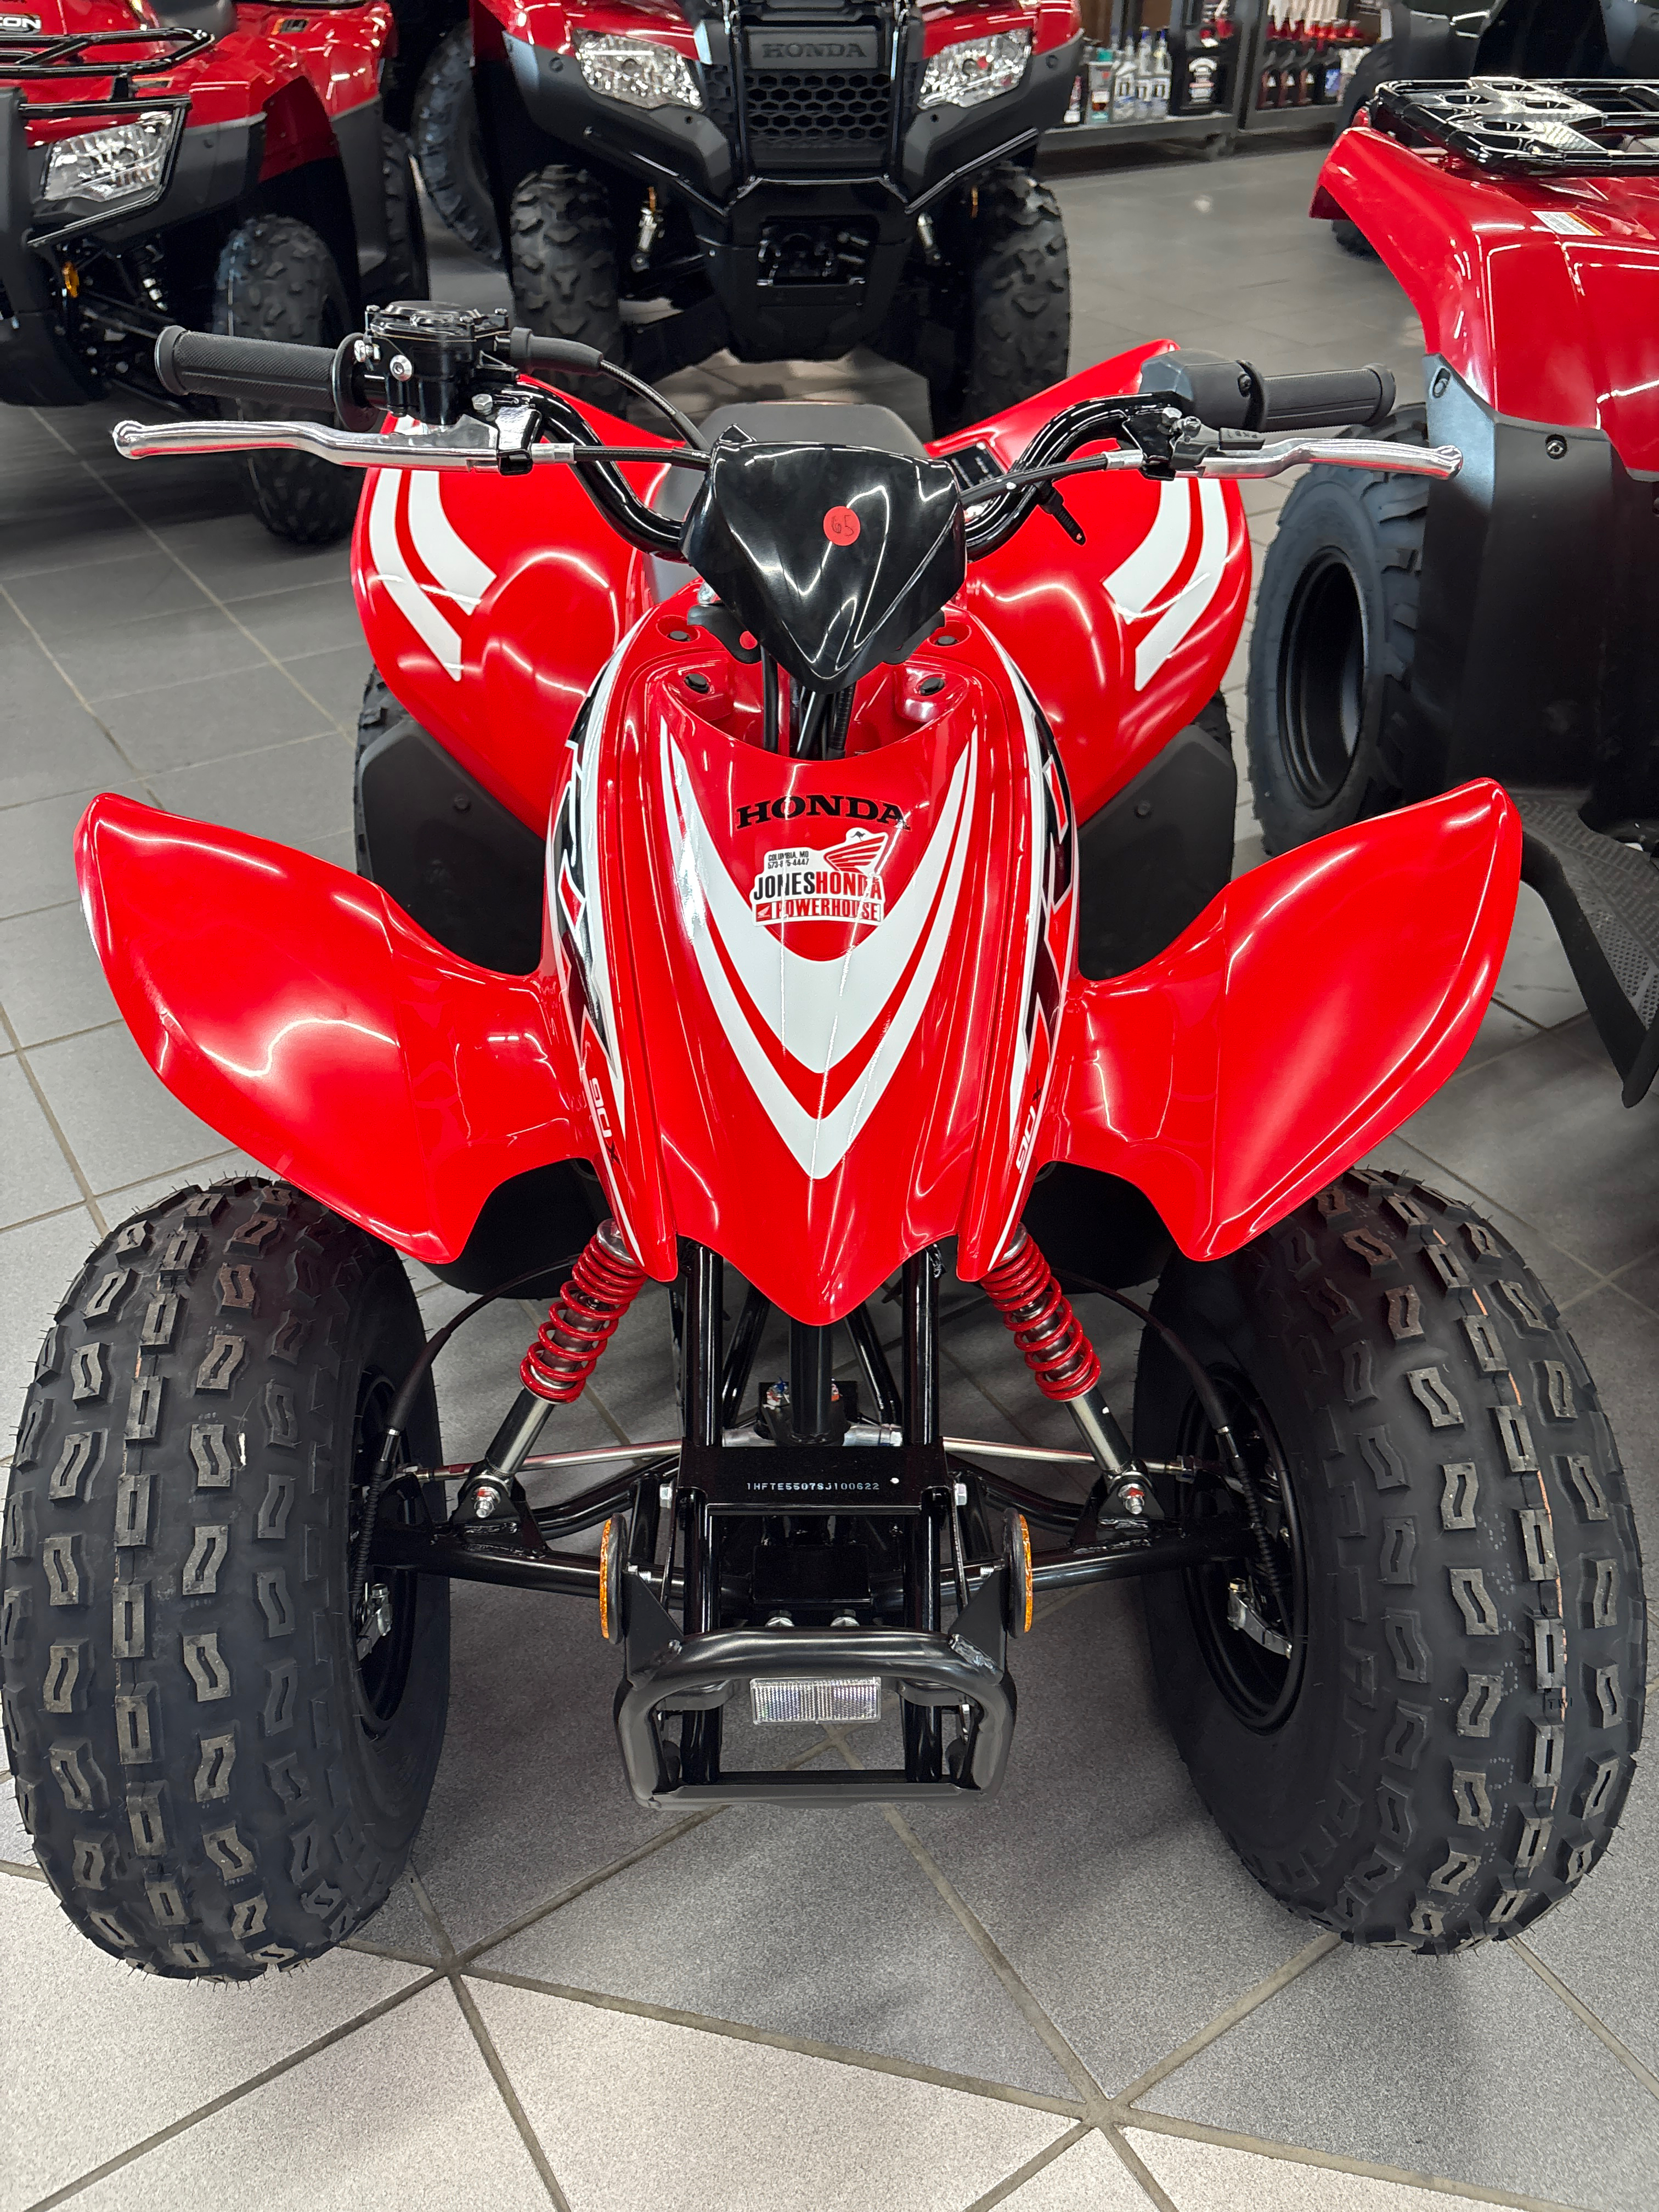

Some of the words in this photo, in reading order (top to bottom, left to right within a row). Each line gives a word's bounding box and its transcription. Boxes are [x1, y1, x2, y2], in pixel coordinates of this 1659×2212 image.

[0, 16, 41, 29] ON
[761, 43, 867, 58] HONDA
[831, 515, 854, 537] 65
[737, 794, 911, 830] HONDA
[768, 858, 809, 869] 573-85-4447
